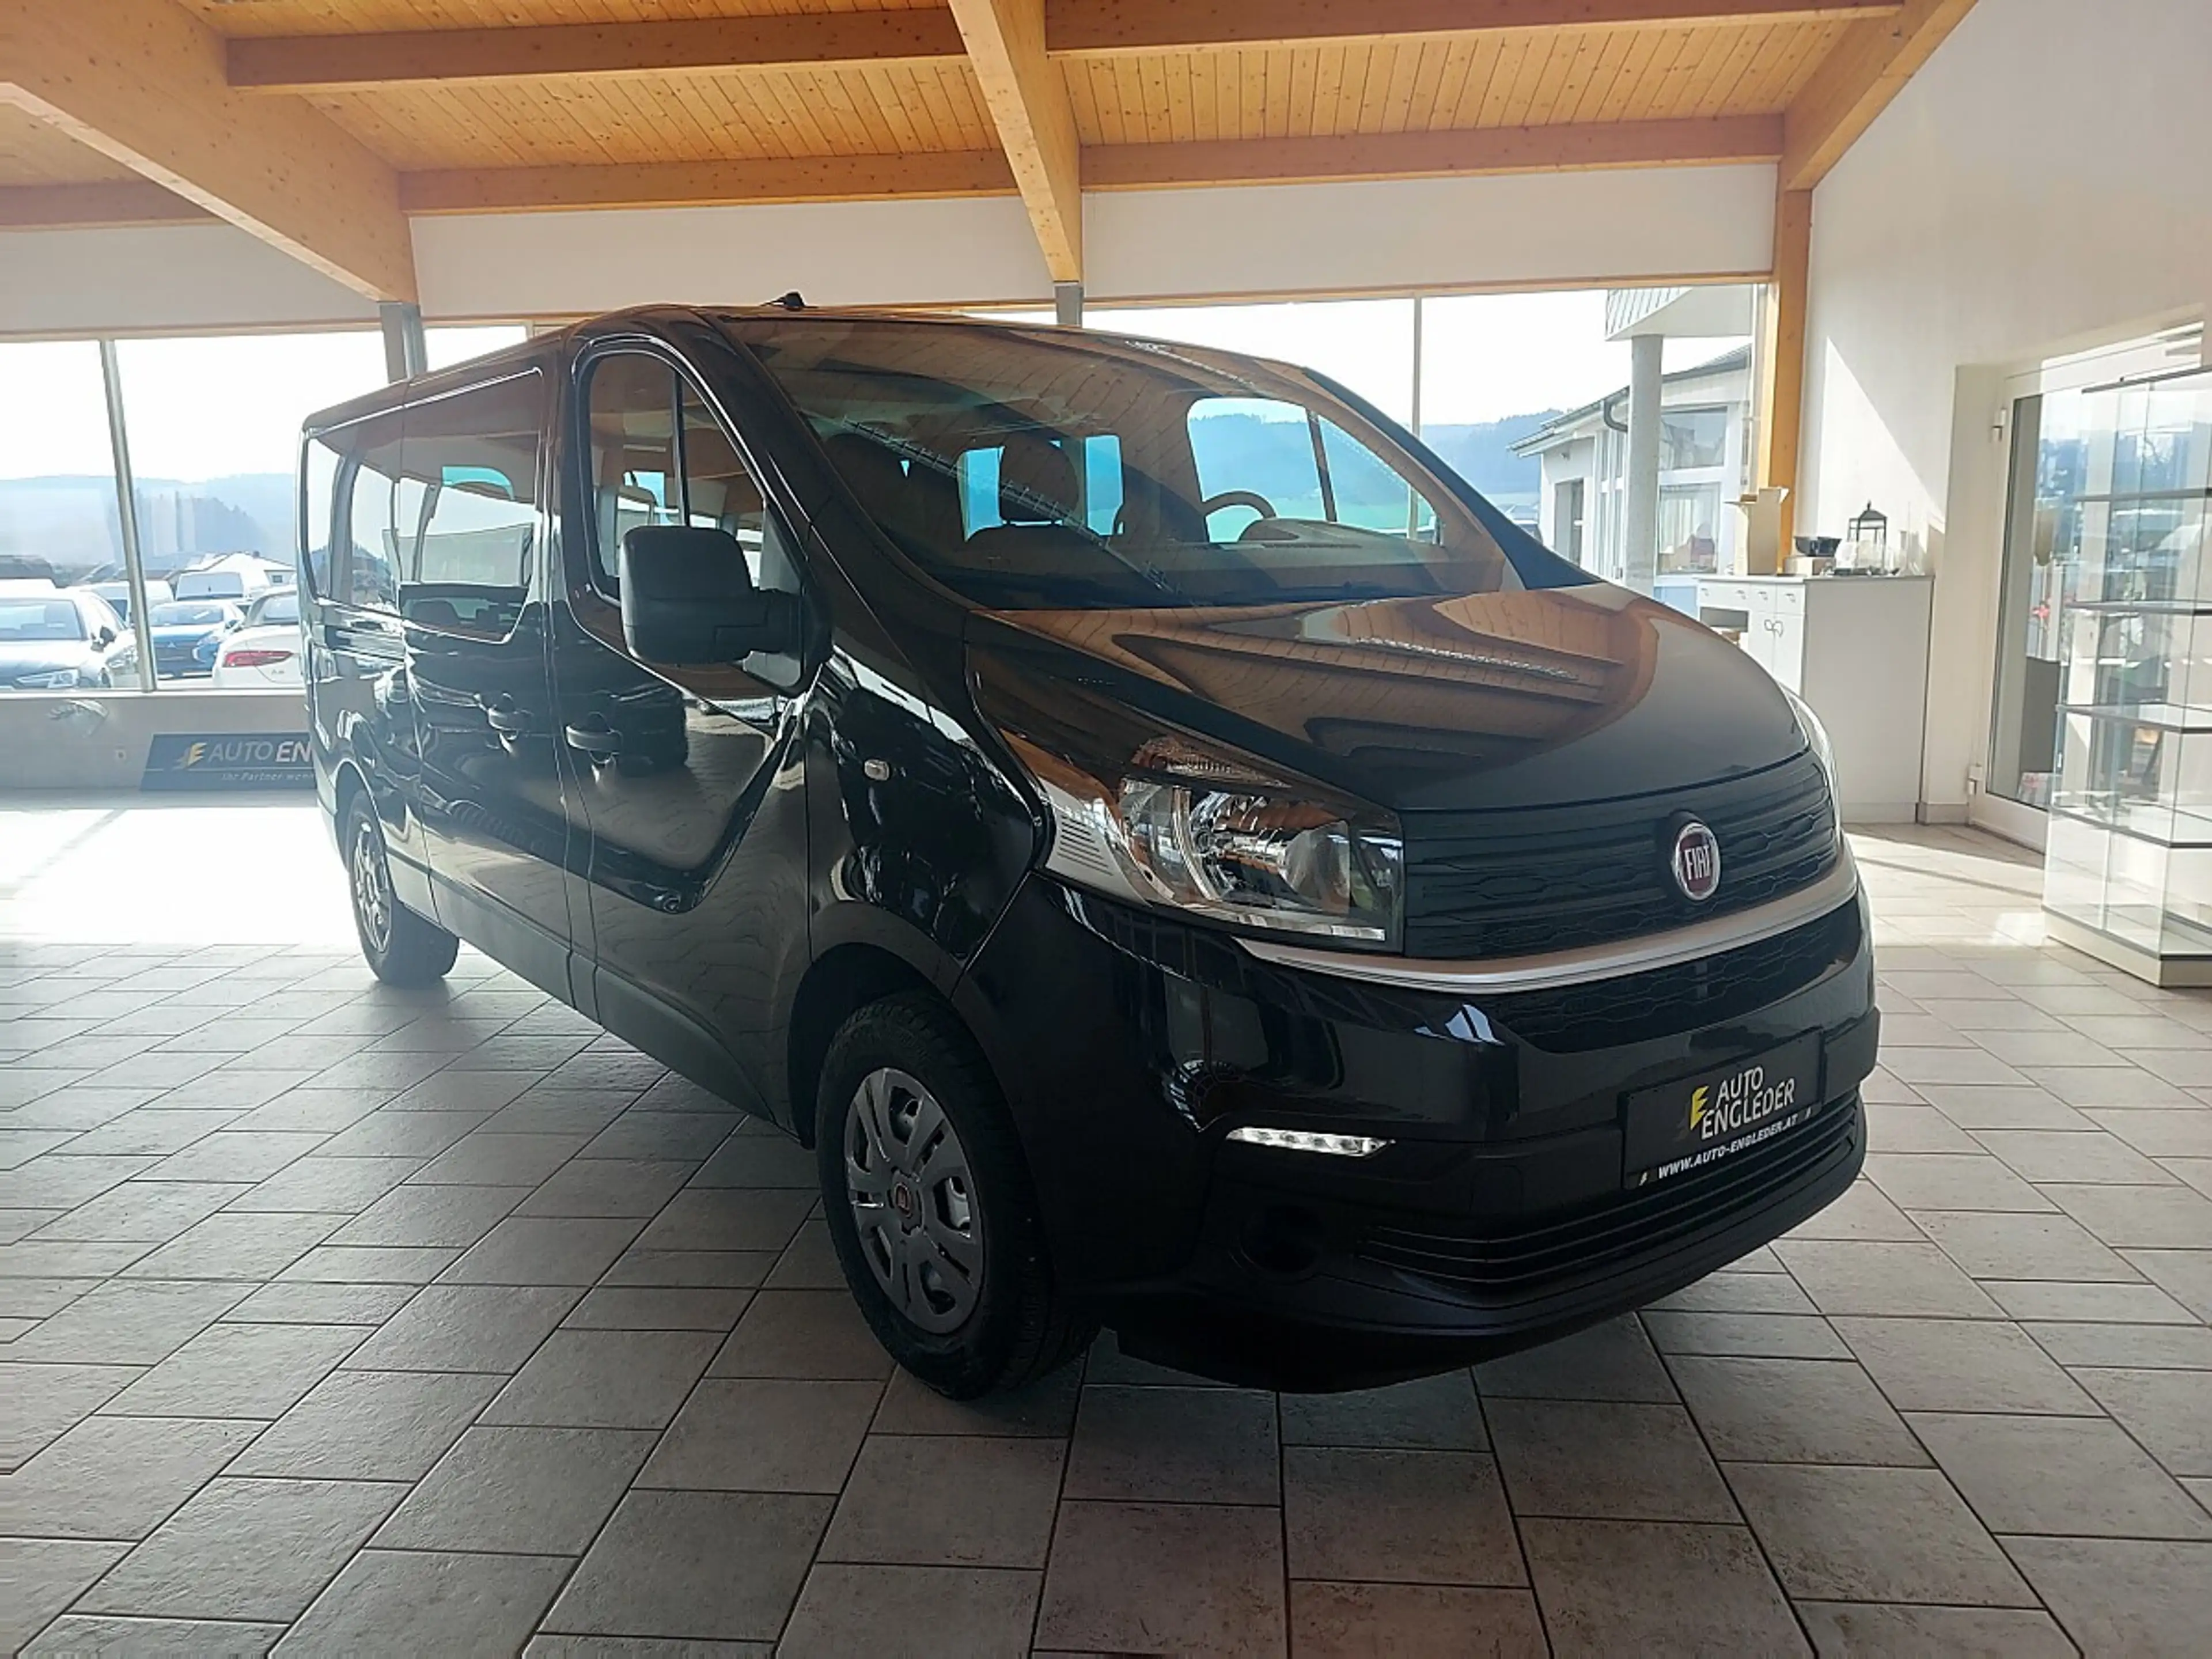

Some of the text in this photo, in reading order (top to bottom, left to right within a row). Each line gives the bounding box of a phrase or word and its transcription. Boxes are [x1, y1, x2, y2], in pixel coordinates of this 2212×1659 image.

[208, 741, 274, 762] AUTO
[275, 741, 312, 762] EN
[240, 772, 282, 782] Partner
[1684, 845, 1710, 880] FIAT
[1715, 1066, 1764, 1108] AUTO
[1701, 1078, 1795, 1140] ENGLEDER
[1658, 1113, 1798, 1179] WWW.AUTO-ENGLEDER.AT
